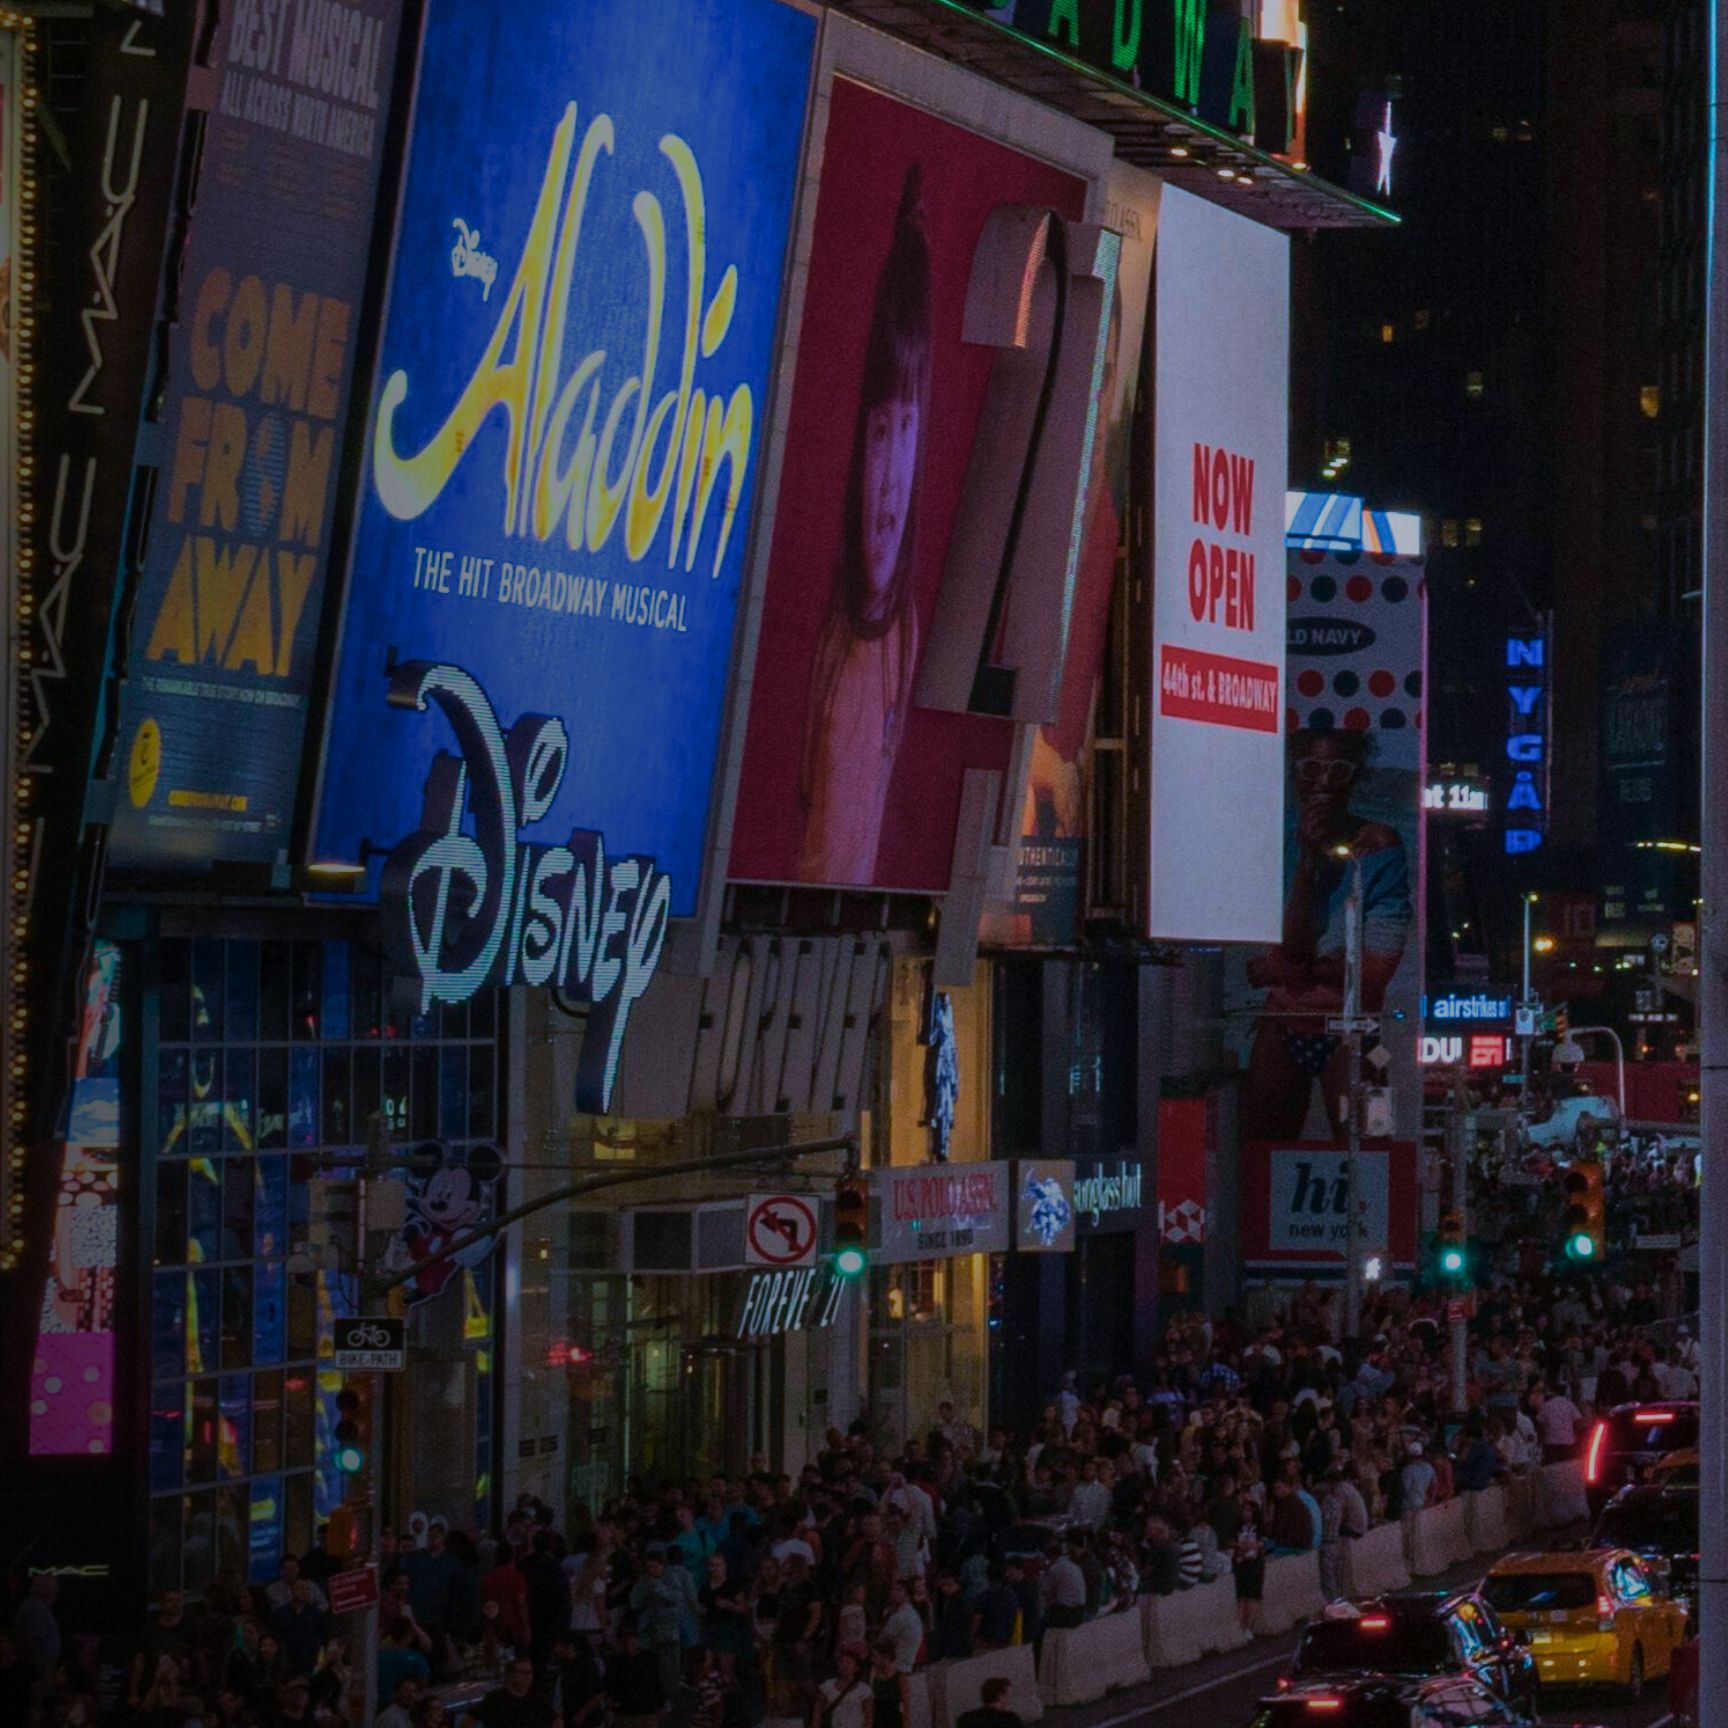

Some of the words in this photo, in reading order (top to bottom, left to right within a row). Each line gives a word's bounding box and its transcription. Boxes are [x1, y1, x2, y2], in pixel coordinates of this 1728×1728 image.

[190, 268, 353, 420] COME
[373, 100, 753, 579] Aladdin
[1192, 441, 1256, 536] NOW
[144, 532, 318, 679] AWAY
[413, 546, 452, 596] THE
[457, 554, 494, 601] HIT
[498, 561, 609, 615] BROADWAY
[611, 588, 688, 633] MUSICAL
[1187, 537, 1256, 633] OPEN
[1217, 680, 1278, 715] BROADWAY
[1289, 1223, 1325, 1239] new
